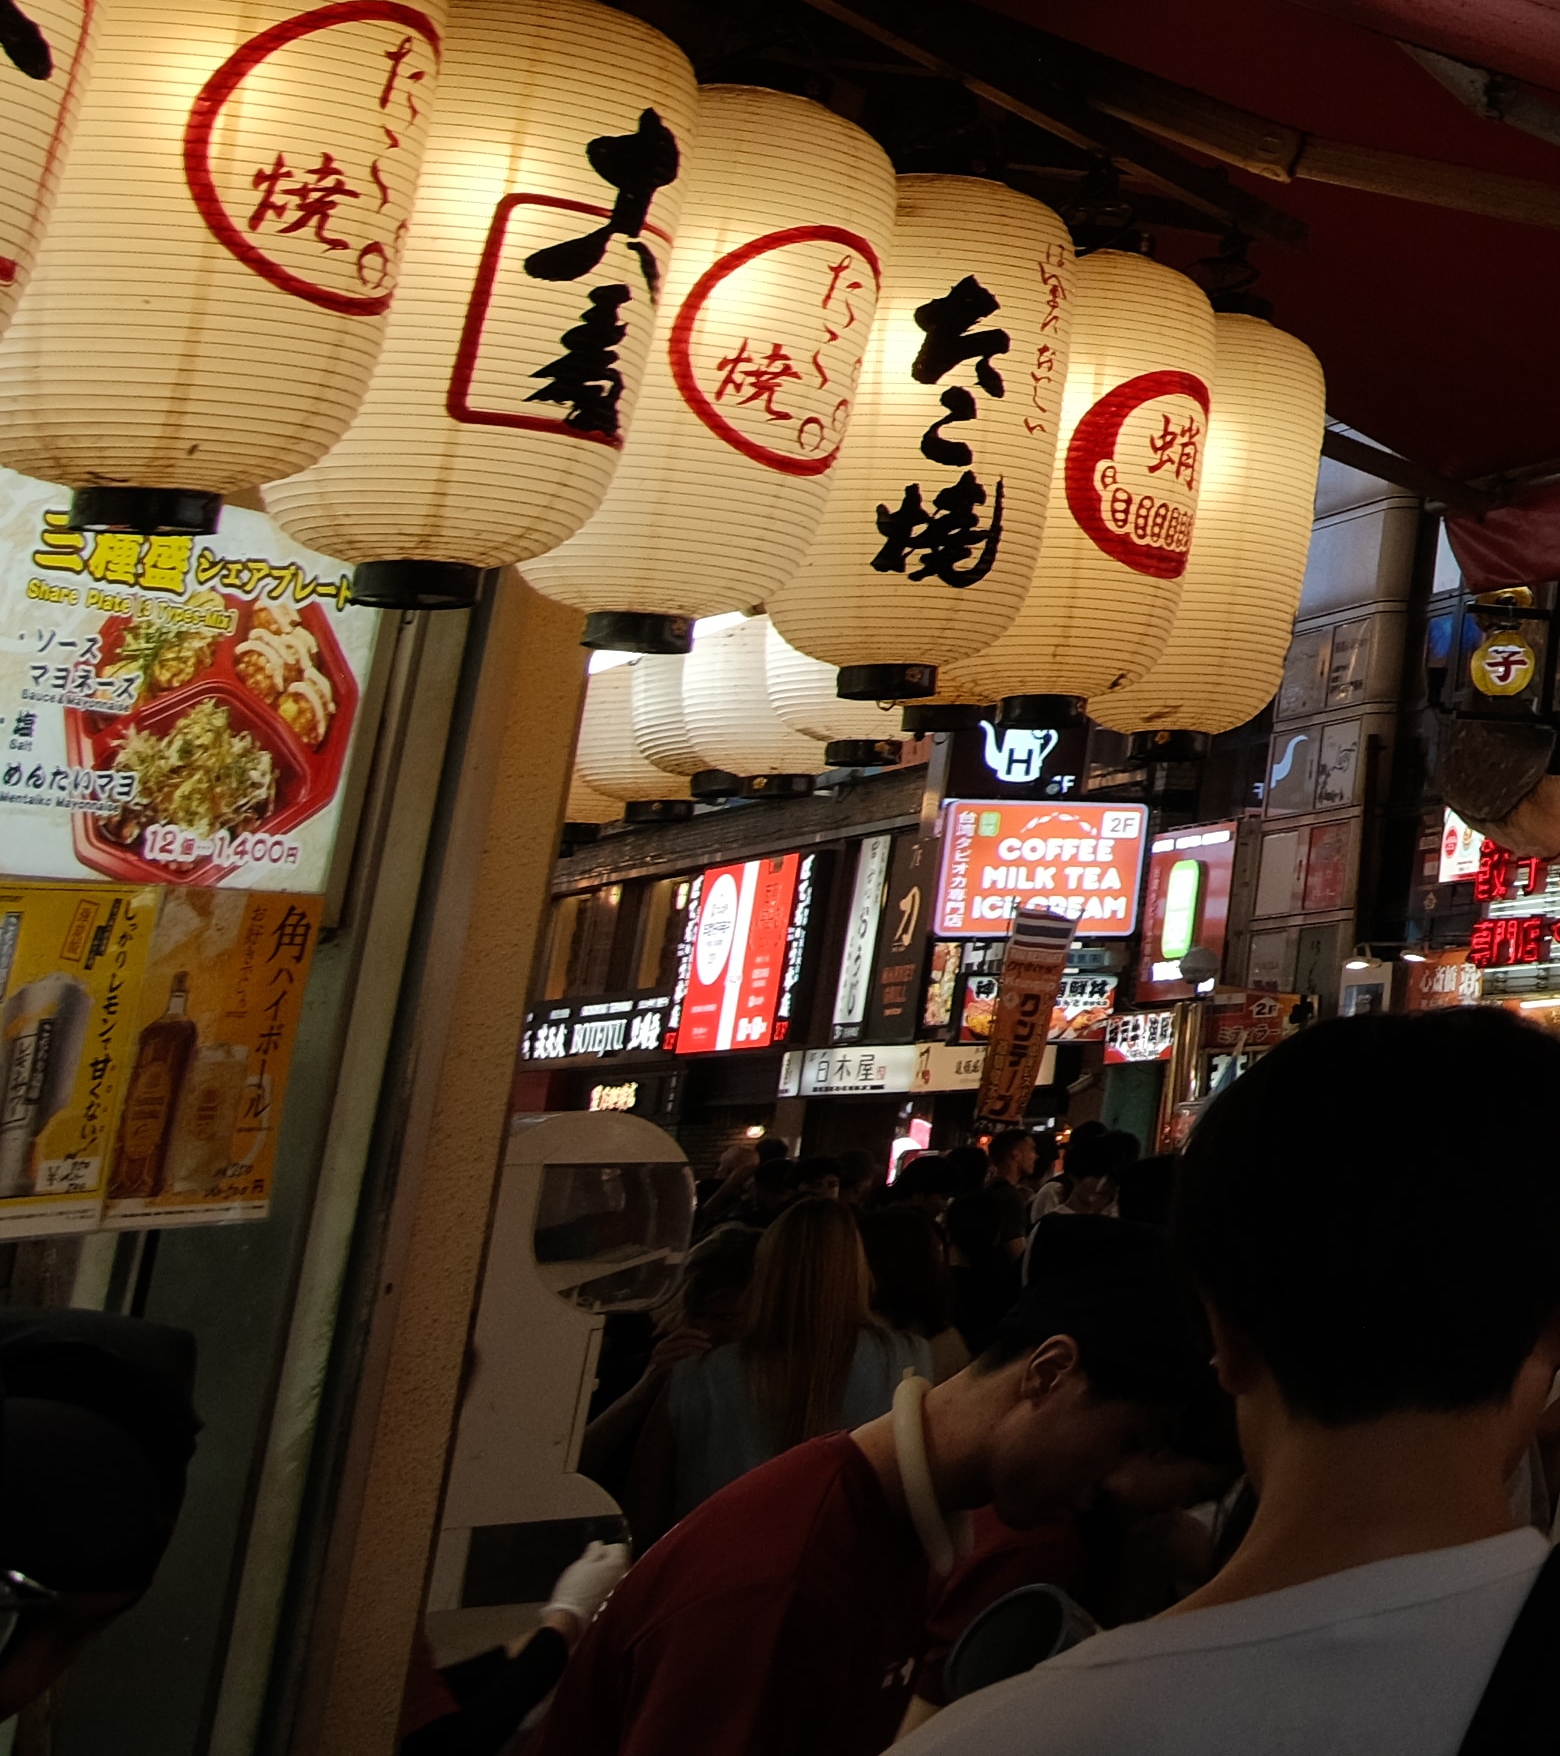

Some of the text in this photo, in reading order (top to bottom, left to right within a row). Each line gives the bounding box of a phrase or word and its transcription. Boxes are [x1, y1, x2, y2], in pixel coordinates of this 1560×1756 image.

[869, 273, 1011, 592] たこ焼
[26, 576, 133, 618] Share Plate
[14, 711, 38, 740] 塩
[1005, 747, 1034, 777] H
[2, 761, 137, 801] めんたいマヨ
[1109, 817, 1137, 835] 2F
[997, 837, 1115, 862] COFFEE
[981, 866, 1122, 891] MILK TEA
[971, 895, 1019, 920] ICE
[1469, 916, 1544, 967] 専門店
[242, 904, 313, 1121] 角ハイボール
[1256, 1000, 1278, 1017] 2F
[815, 1053, 877, 1084] 白木屋
